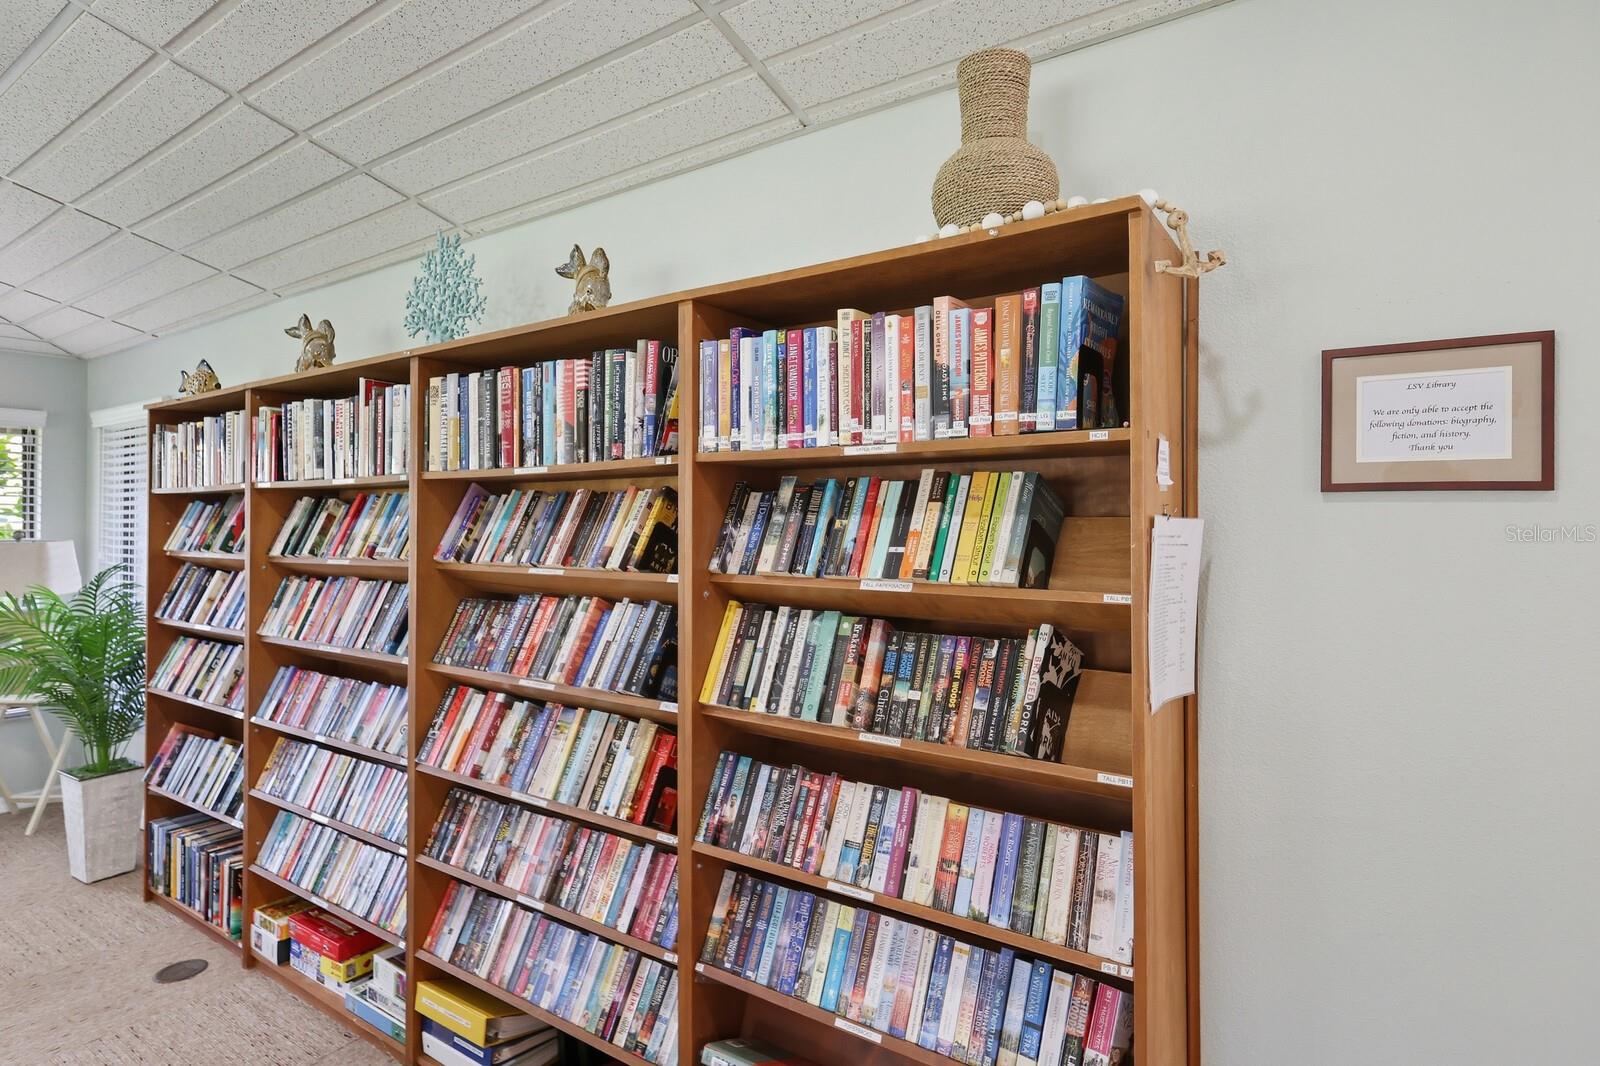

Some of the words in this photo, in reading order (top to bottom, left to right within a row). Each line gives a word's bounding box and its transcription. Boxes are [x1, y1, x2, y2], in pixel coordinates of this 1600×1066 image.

[974, 327, 987, 350] JAMES
[789, 343, 797, 362] JANET
[789, 364, 797, 400] EVANOVICH
[974, 352, 987, 390] PATTERSON
[1407, 382, 1424, 390] LSV
[1426, 380, 1457, 390] Library
[1373, 408, 1384, 416] We
[1386, 408, 1399, 416] are
[1402, 406, 1420, 416] only
[1422, 405, 1439, 413] able
[1441, 405, 1449, 413] to
[1451, 404, 1478, 414] accept
[1480, 402, 1494, 410] the
[1368, 420, 1405, 430] following
[1407, 417, 1448, 427] donations:
[1450, 416, 1497, 427] biography,
[1391, 431, 1418, 443] fiction,
[1420, 430, 1437, 438] and
[1439, 430, 1471, 440] history.
[1409, 443, 1436, 451] Thank
[1437, 444, 1454, 453] you
[729, 479, 745, 505] Daniel
[968, 494, 983, 503] Help
[1021, 479, 1035, 503] Maine
[723, 505, 737, 525] Silva
[754, 506, 767, 531] Daniel
[748, 530, 760, 549] Silva
[976, 513, 988, 545] Elizabeth
[988, 515, 999, 545] Elizabeth
[972, 545, 981, 566] Strout
[984, 544, 993, 564] Strout
[846, 623, 862, 664] Krakatoa
[898, 652, 908, 678] WOODS
[904, 653, 914, 679] STUART
[939, 653, 950, 676] STUART
[953, 652, 964, 679] STUART
[1016, 644, 1025, 669] STUART
[978, 660, 988, 687] WOODS
[984, 660, 995, 687] STUART
[1011, 672, 1021, 699] WOODS
[1025, 654, 1042, 701] BRAISED
[935, 678, 945, 701] WOODS
[948, 681, 959, 708] WOODS
[874, 688, 890, 722] Chiefs
[992, 696, 1000, 716] UNDER
[1018, 704, 1032, 734] PORK
[601, 761, 612, 780] FINAL
[592, 779, 605, 802] STORM
[866, 823, 878, 837] THE
[1008, 820, 1018, 837] Nora
[952, 831, 961, 854] NORA
[979, 836, 989, 868] ROBERTS
[987, 842, 995, 864] NORA
[1004, 838, 1015, 865] Roberts
[1024, 834, 1038, 859] NORA
[1058, 844, 1068, 868] NORA
[1077, 850, 1089, 874] NORA
[1020, 859, 1034, 891] ROBERTS
[1125, 857, 1133, 886] Roberts
[775, 901, 783, 914] LISA
[766, 915, 780, 950] SCOTTOLINE
[797, 914, 808, 939] Daniel
[887, 932, 898, 967] STEWART
[894, 937, 904, 968] MARIAH
[899, 945, 911, 984] STEWART
[906, 949, 918, 984] MARIAH
[633, 974, 645, 992] THE
[625, 990, 640, 1013] JUDGE
[993, 988, 1004, 1006] See
[1026, 975, 1041, 1018] WILLIAMS
[974, 1009, 983, 1031] MOON
[989, 1008, 1000, 1032] them
[1067, 995, 1081, 1034] WOODS
[1076, 997, 1090, 1037] STUART
[985, 1033, 995, 1052] run
